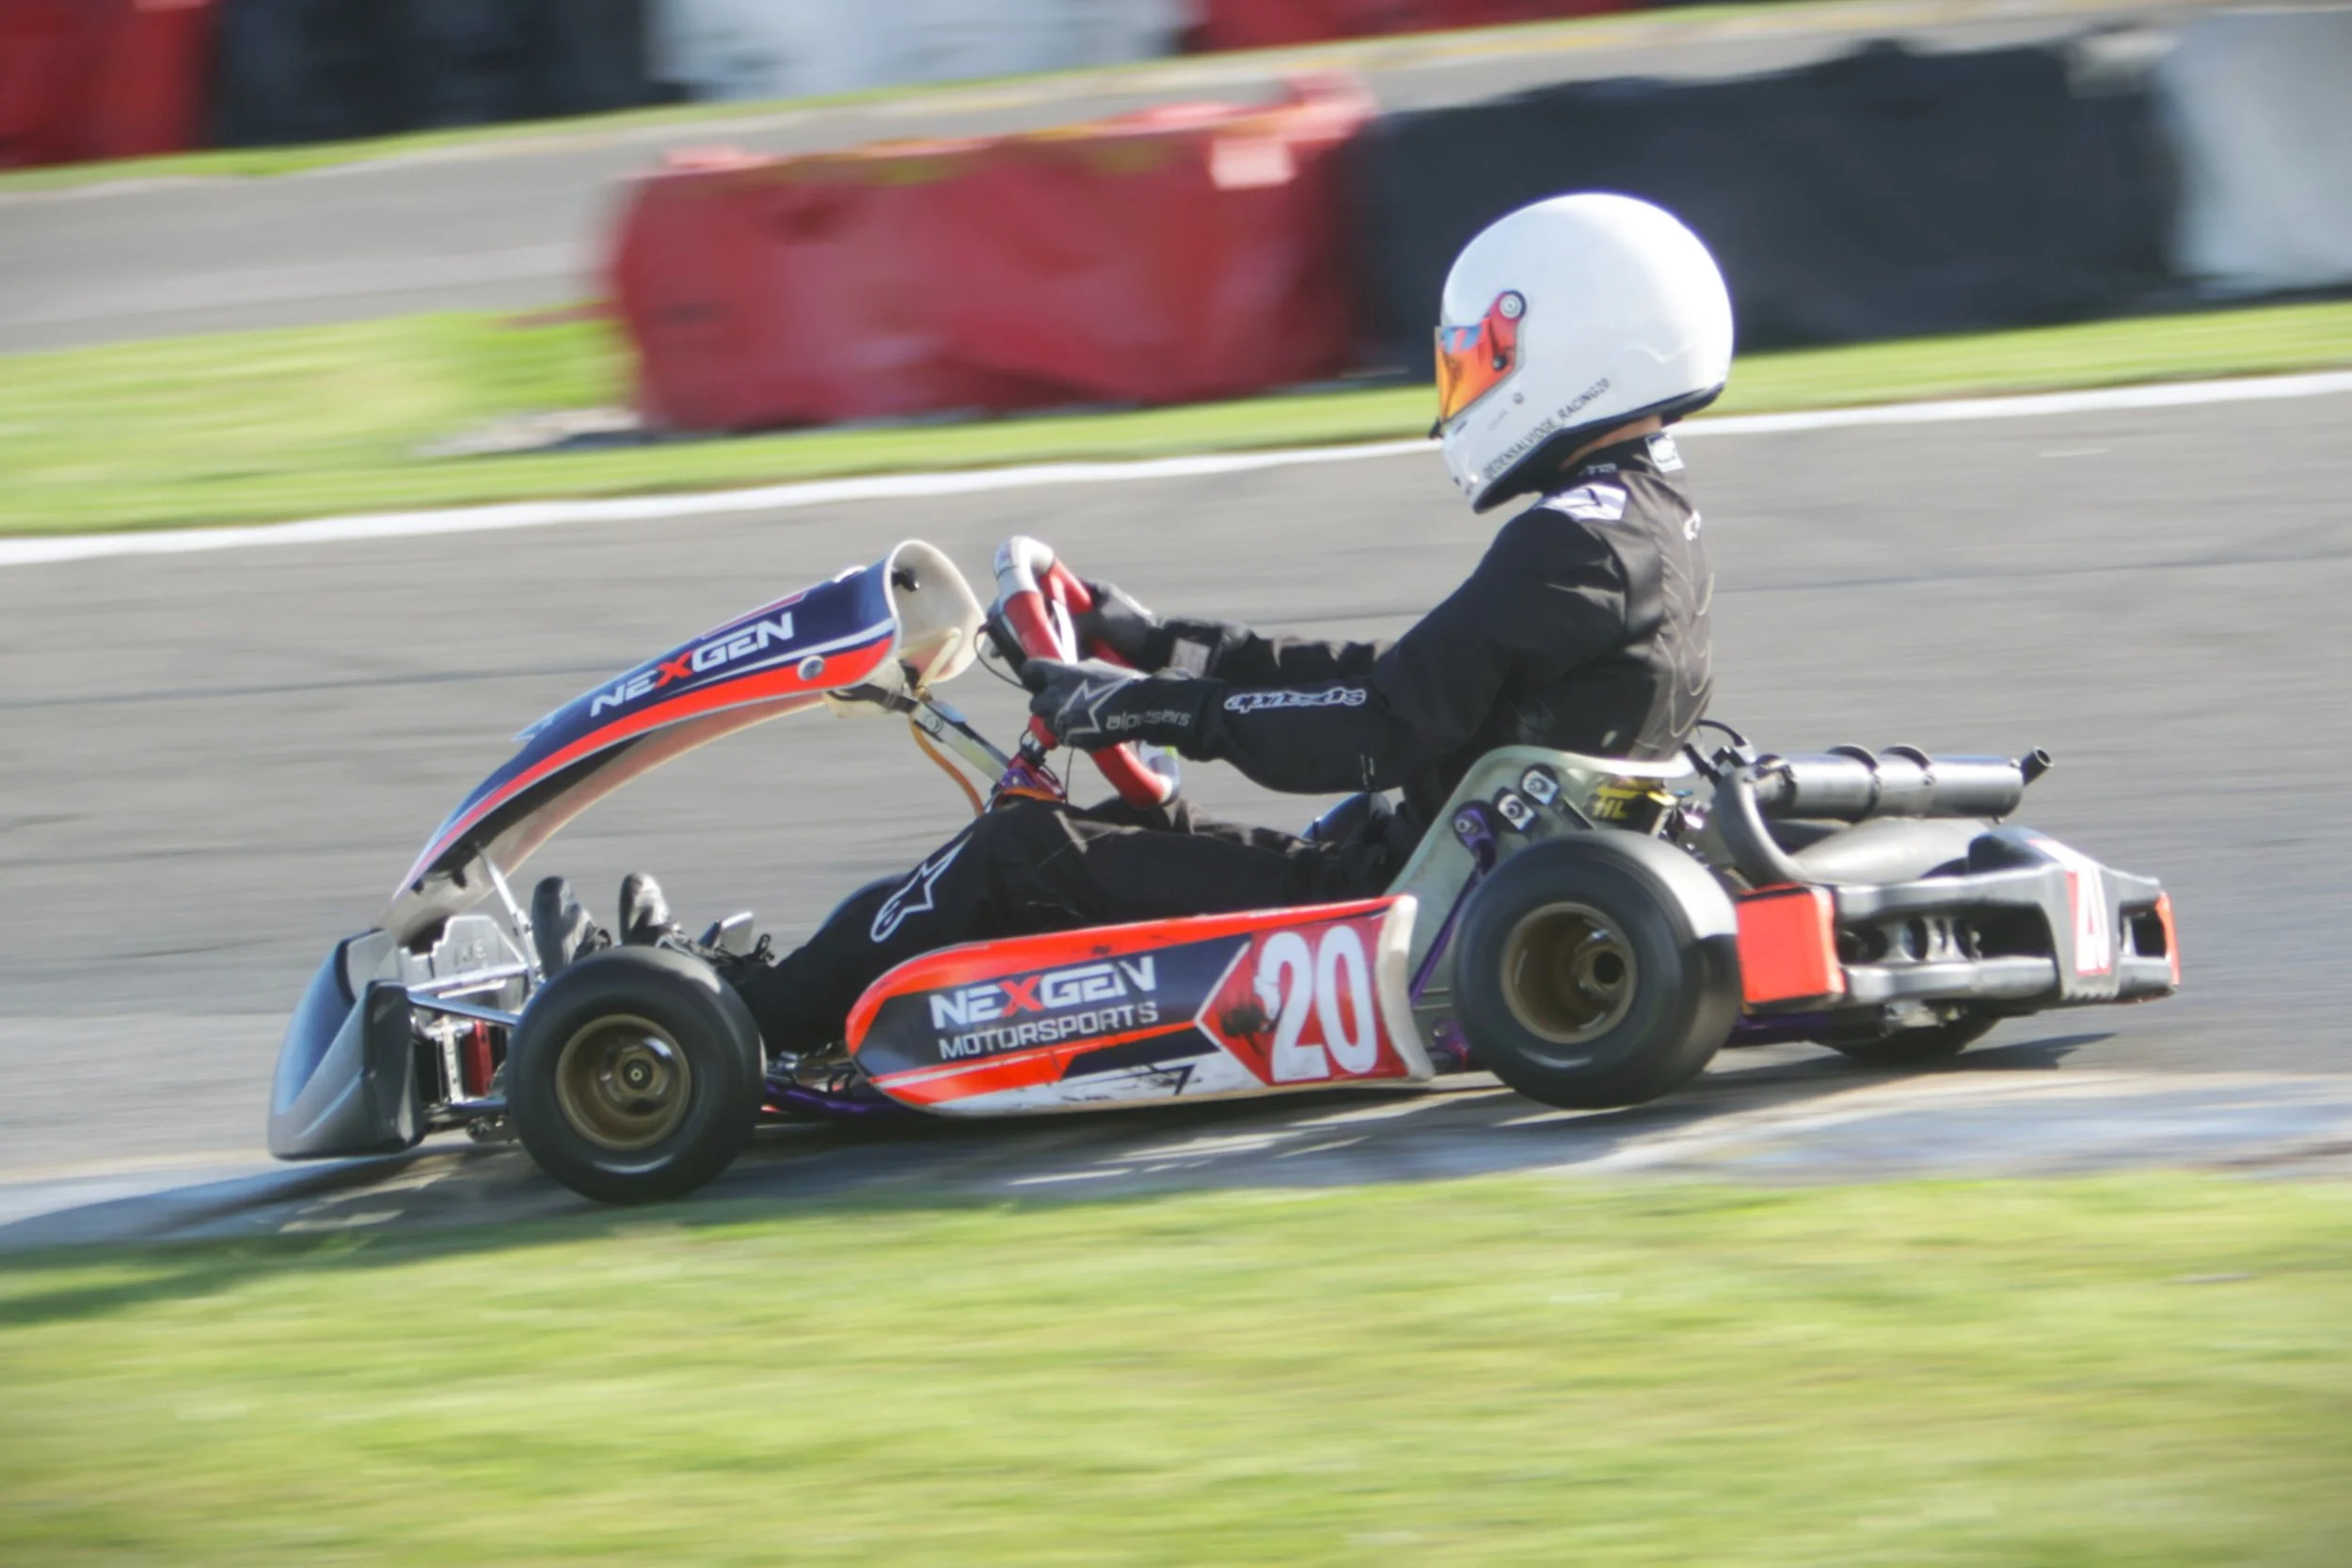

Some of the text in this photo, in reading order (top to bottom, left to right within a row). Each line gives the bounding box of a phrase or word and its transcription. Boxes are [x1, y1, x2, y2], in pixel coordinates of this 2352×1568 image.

[590, 612, 795, 718] NEXGEN
[929, 955, 1157, 1030] NEXGEN
[939, 1000, 1159, 1060] MOTORSPORTS
[1254, 925, 1377, 1082] 20
